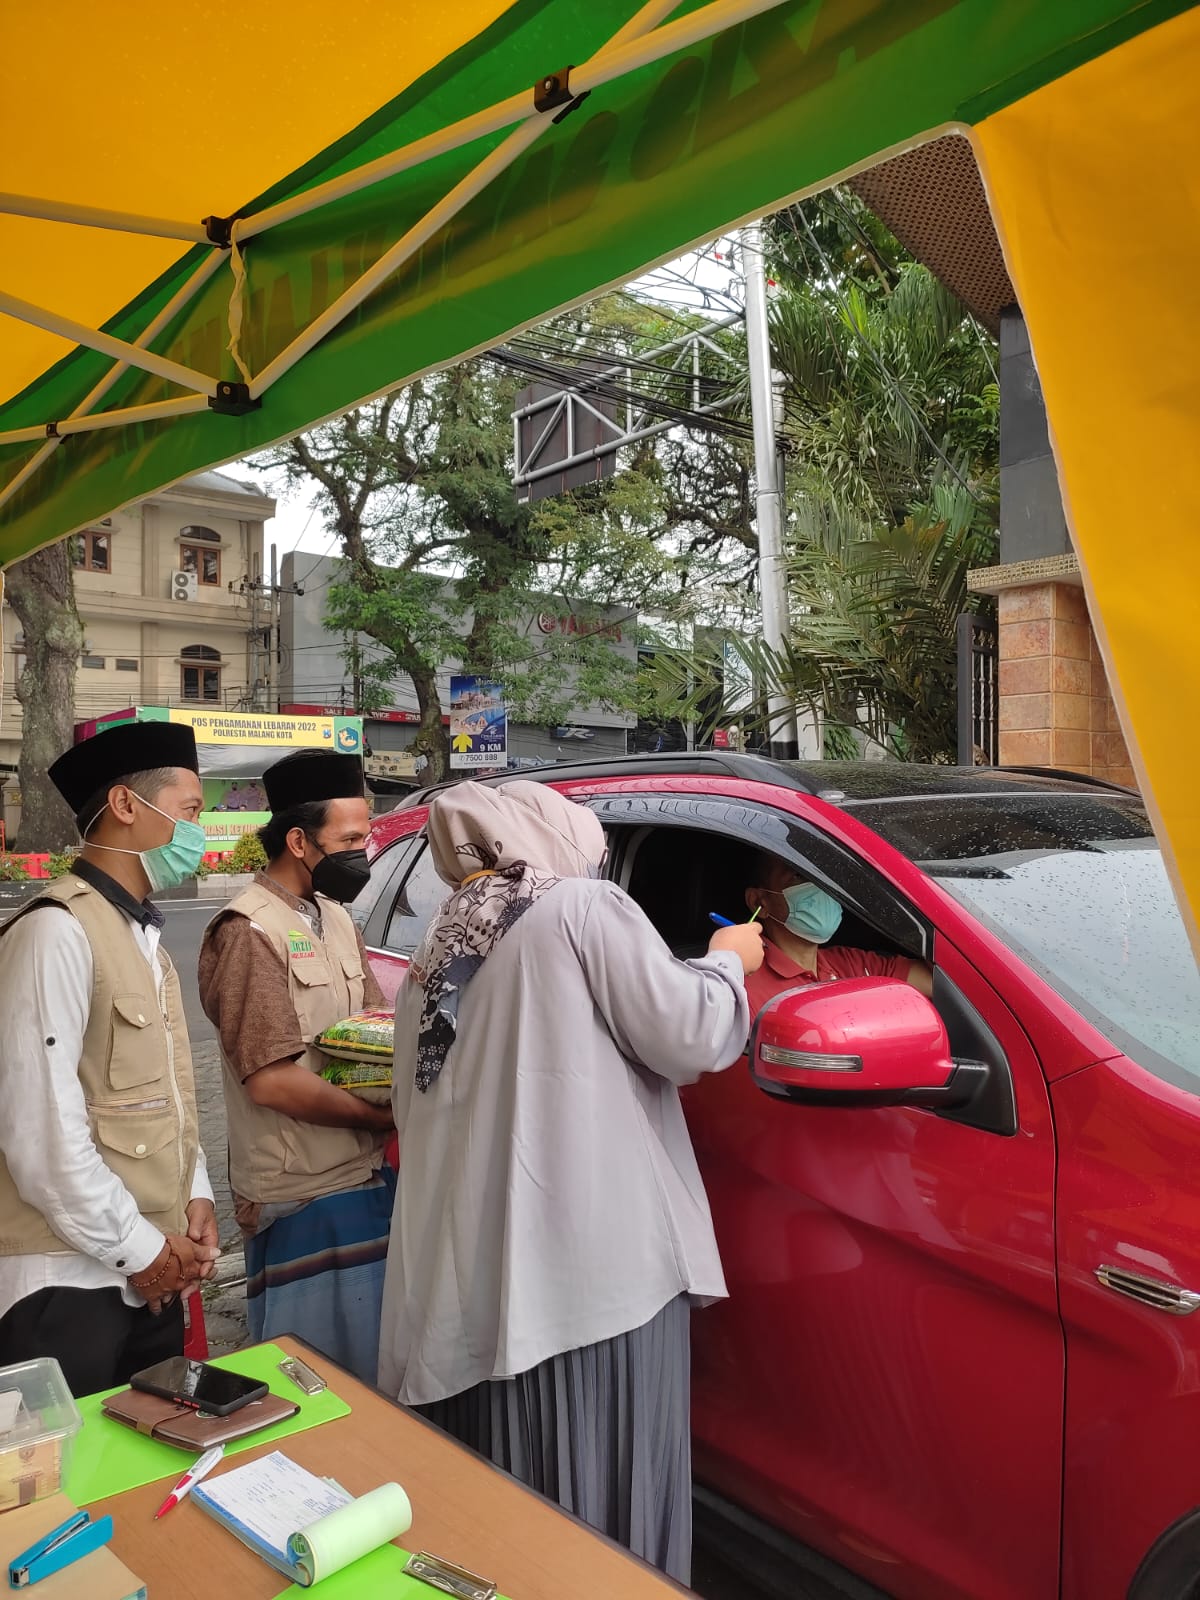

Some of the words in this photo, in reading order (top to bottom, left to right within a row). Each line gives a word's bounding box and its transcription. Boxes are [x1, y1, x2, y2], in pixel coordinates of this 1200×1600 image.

[192, 717, 208, 727] POS
[209, 718, 262, 729] PENGAMANAN
[263, 721, 296, 731] LEBARAN
[297, 722, 317, 732] 2022
[213, 728, 246, 738] POLRESTA
[248, 730, 275, 739] MALANG
[276, 731, 293, 739] KOTA
[480, 743, 486, 752] 9
[487, 743, 501, 752] KM
[465, 754, 483, 762] 7500
